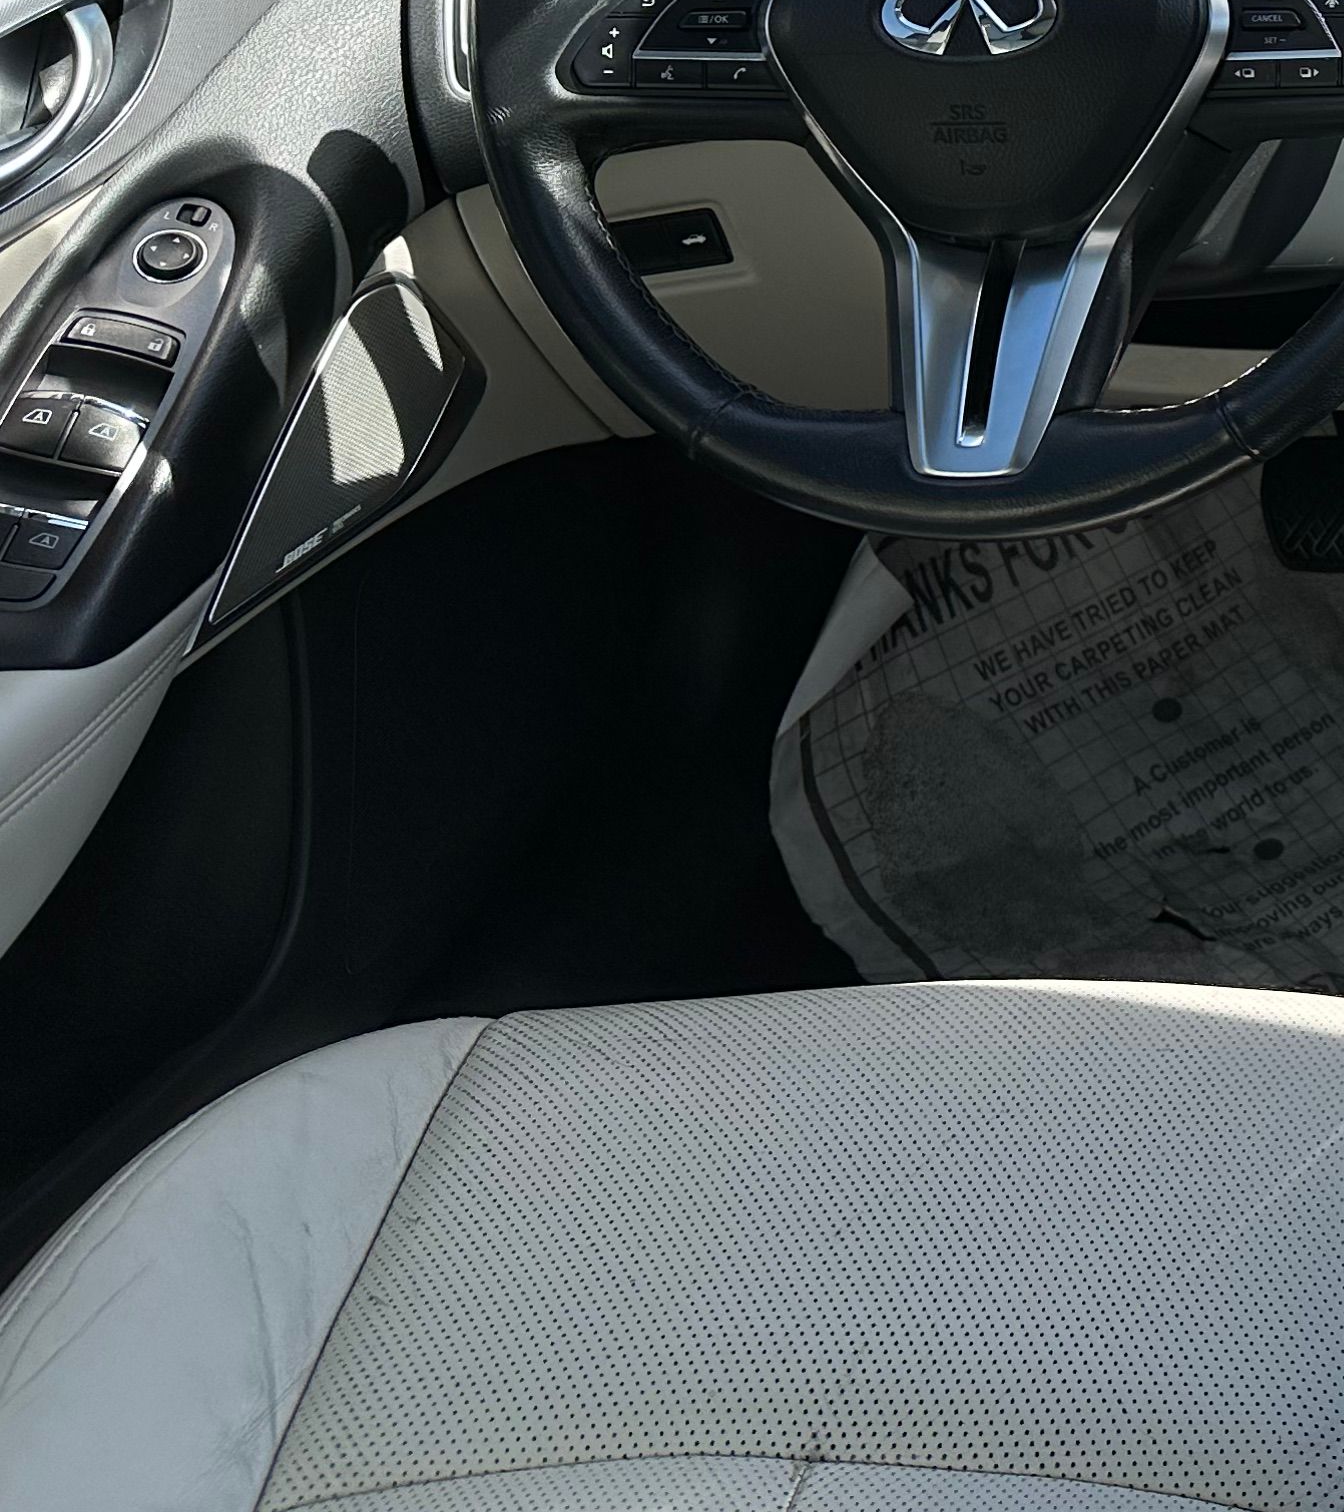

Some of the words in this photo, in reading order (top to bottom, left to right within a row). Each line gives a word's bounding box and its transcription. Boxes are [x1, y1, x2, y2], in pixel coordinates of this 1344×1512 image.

[1251, 14, 1283, 23] CANCEL
[933, 127, 1008, 145] AIRBAG
[949, 103, 986, 121] SRS
[997, 524, 1095, 590] FO
[972, 659, 1011, 683] WE
[1014, 623, 1071, 660] HAVE
[1072, 588, 1138, 633] TRIED
[1137, 568, 1167, 599] TO
[1169, 538, 1219, 581] KEEP
[988, 670, 1054, 714] YOUR
[1054, 604, 1175, 683] CARPETING
[1176, 568, 1244, 618] CLEAN
[1023, 697, 1084, 736] WITH
[1083, 669, 1134, 705] THIS
[1134, 634, 1202, 680] PAPER
[1203, 603, 1248, 642] MAT
[1094, 834, 1129, 863] the
[1130, 799, 1182, 843] most
[1181, 749, 1271, 809] important
[1271, 712, 1336, 760] person
[1132, 775, 1153, 797] A
[1150, 726, 1242, 784] Customer
[1241, 714, 1263, 735] is
[1209, 787, 1267, 833] world
[1266, 778, 1290, 803] to
